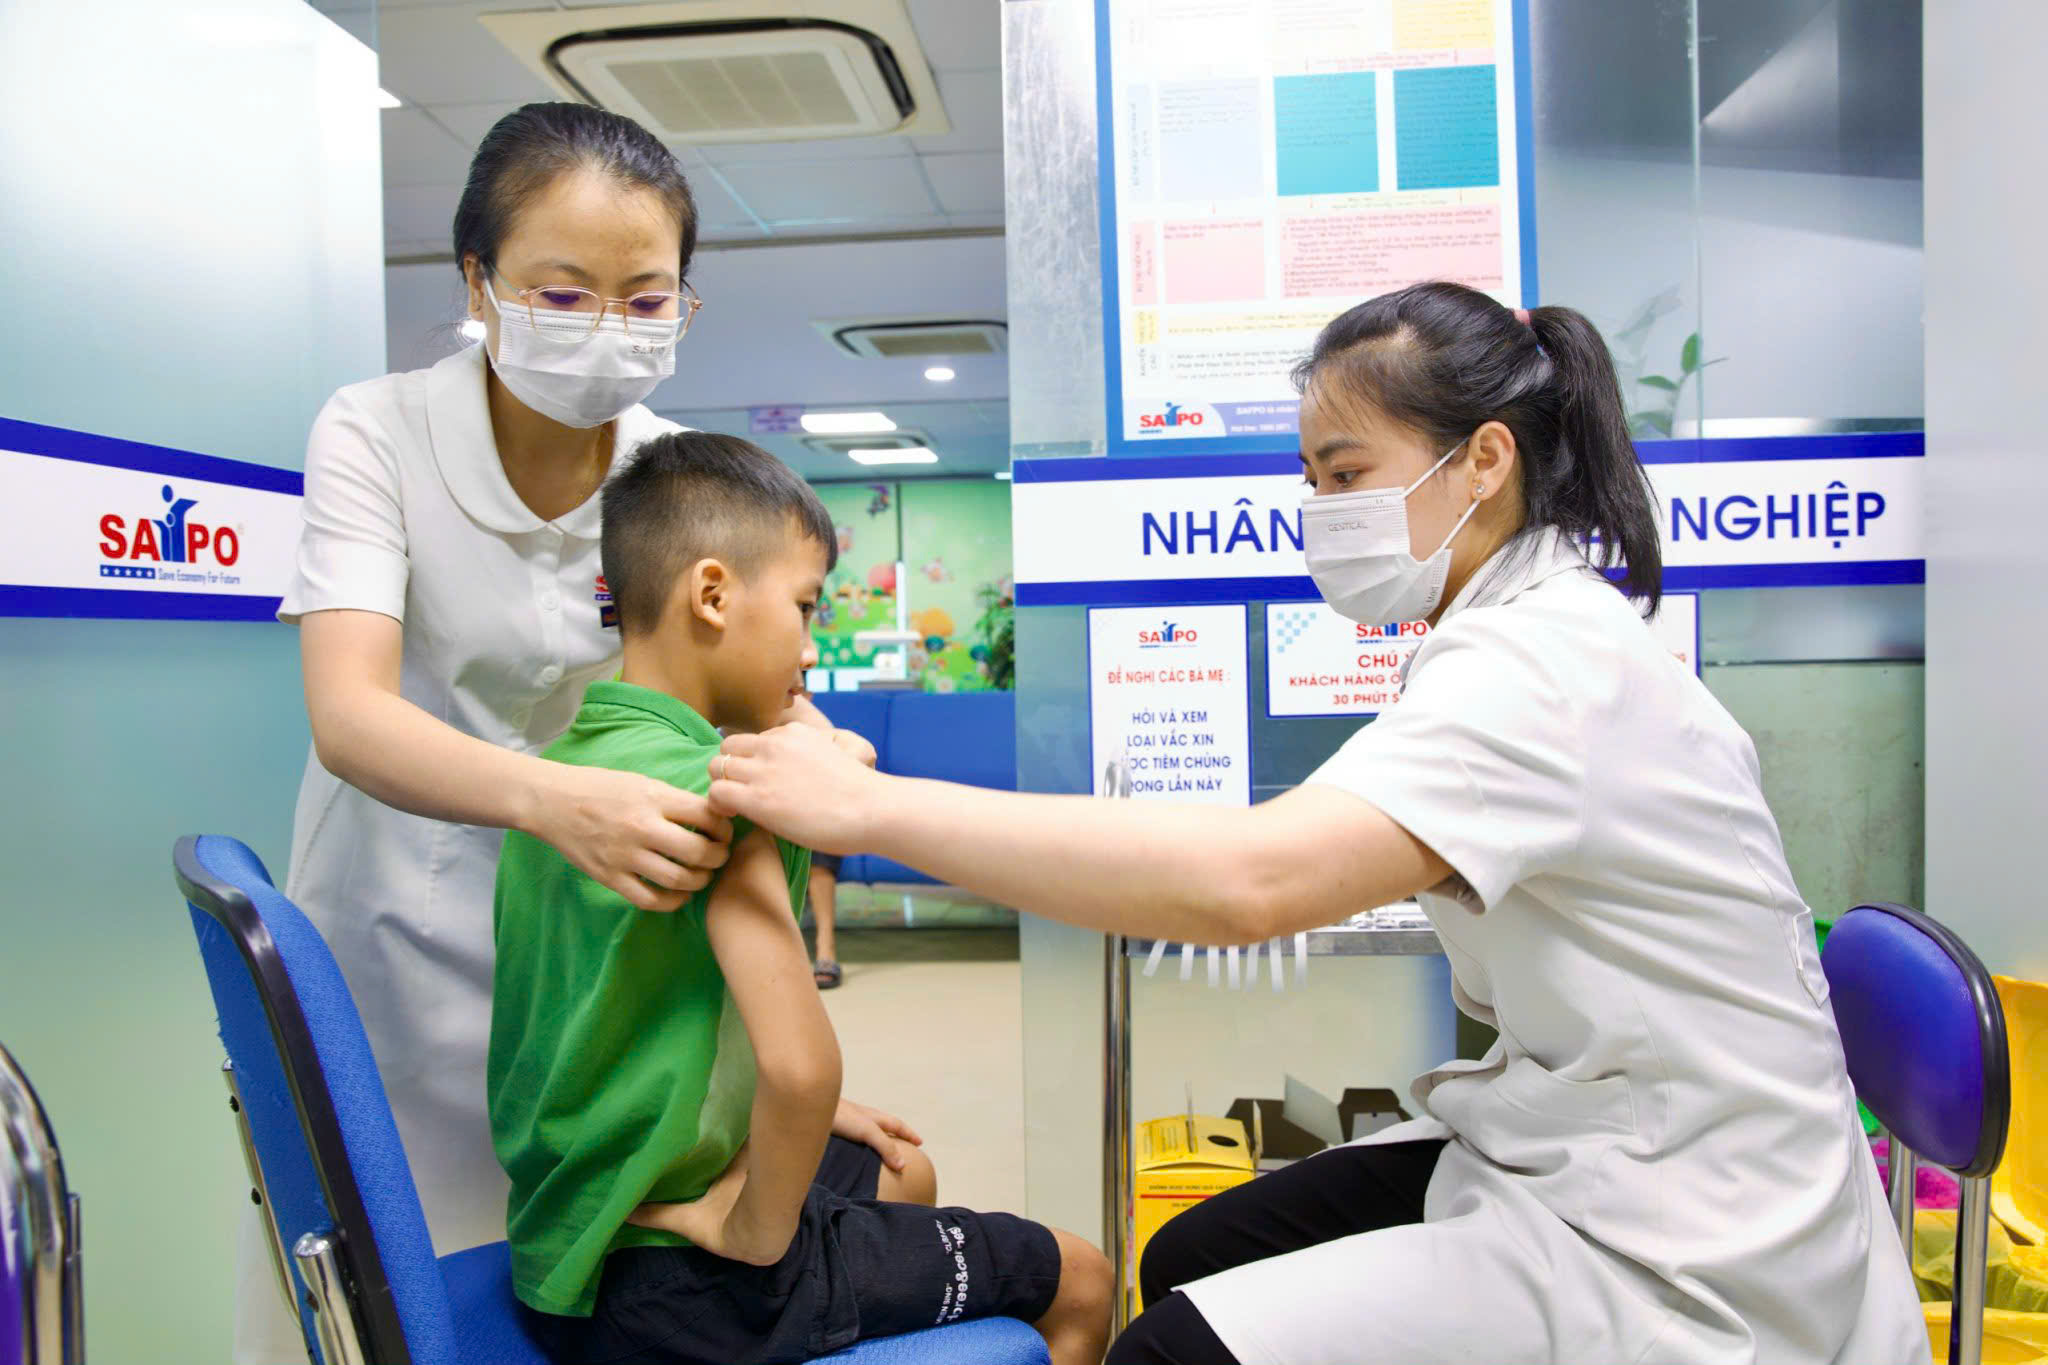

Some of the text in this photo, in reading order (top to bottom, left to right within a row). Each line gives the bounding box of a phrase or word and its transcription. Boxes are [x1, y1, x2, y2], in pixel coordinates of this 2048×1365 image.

[1142, 481, 1886, 555] NHÂN NGHIỆP
[1358, 650, 1398, 668] CHÚ
[1333, 694, 1349, 705] 30
[1354, 690, 1388, 704] PHÚT
[1182, 710, 1208, 723] XEM
[1193, 733, 1214, 745] XIN
